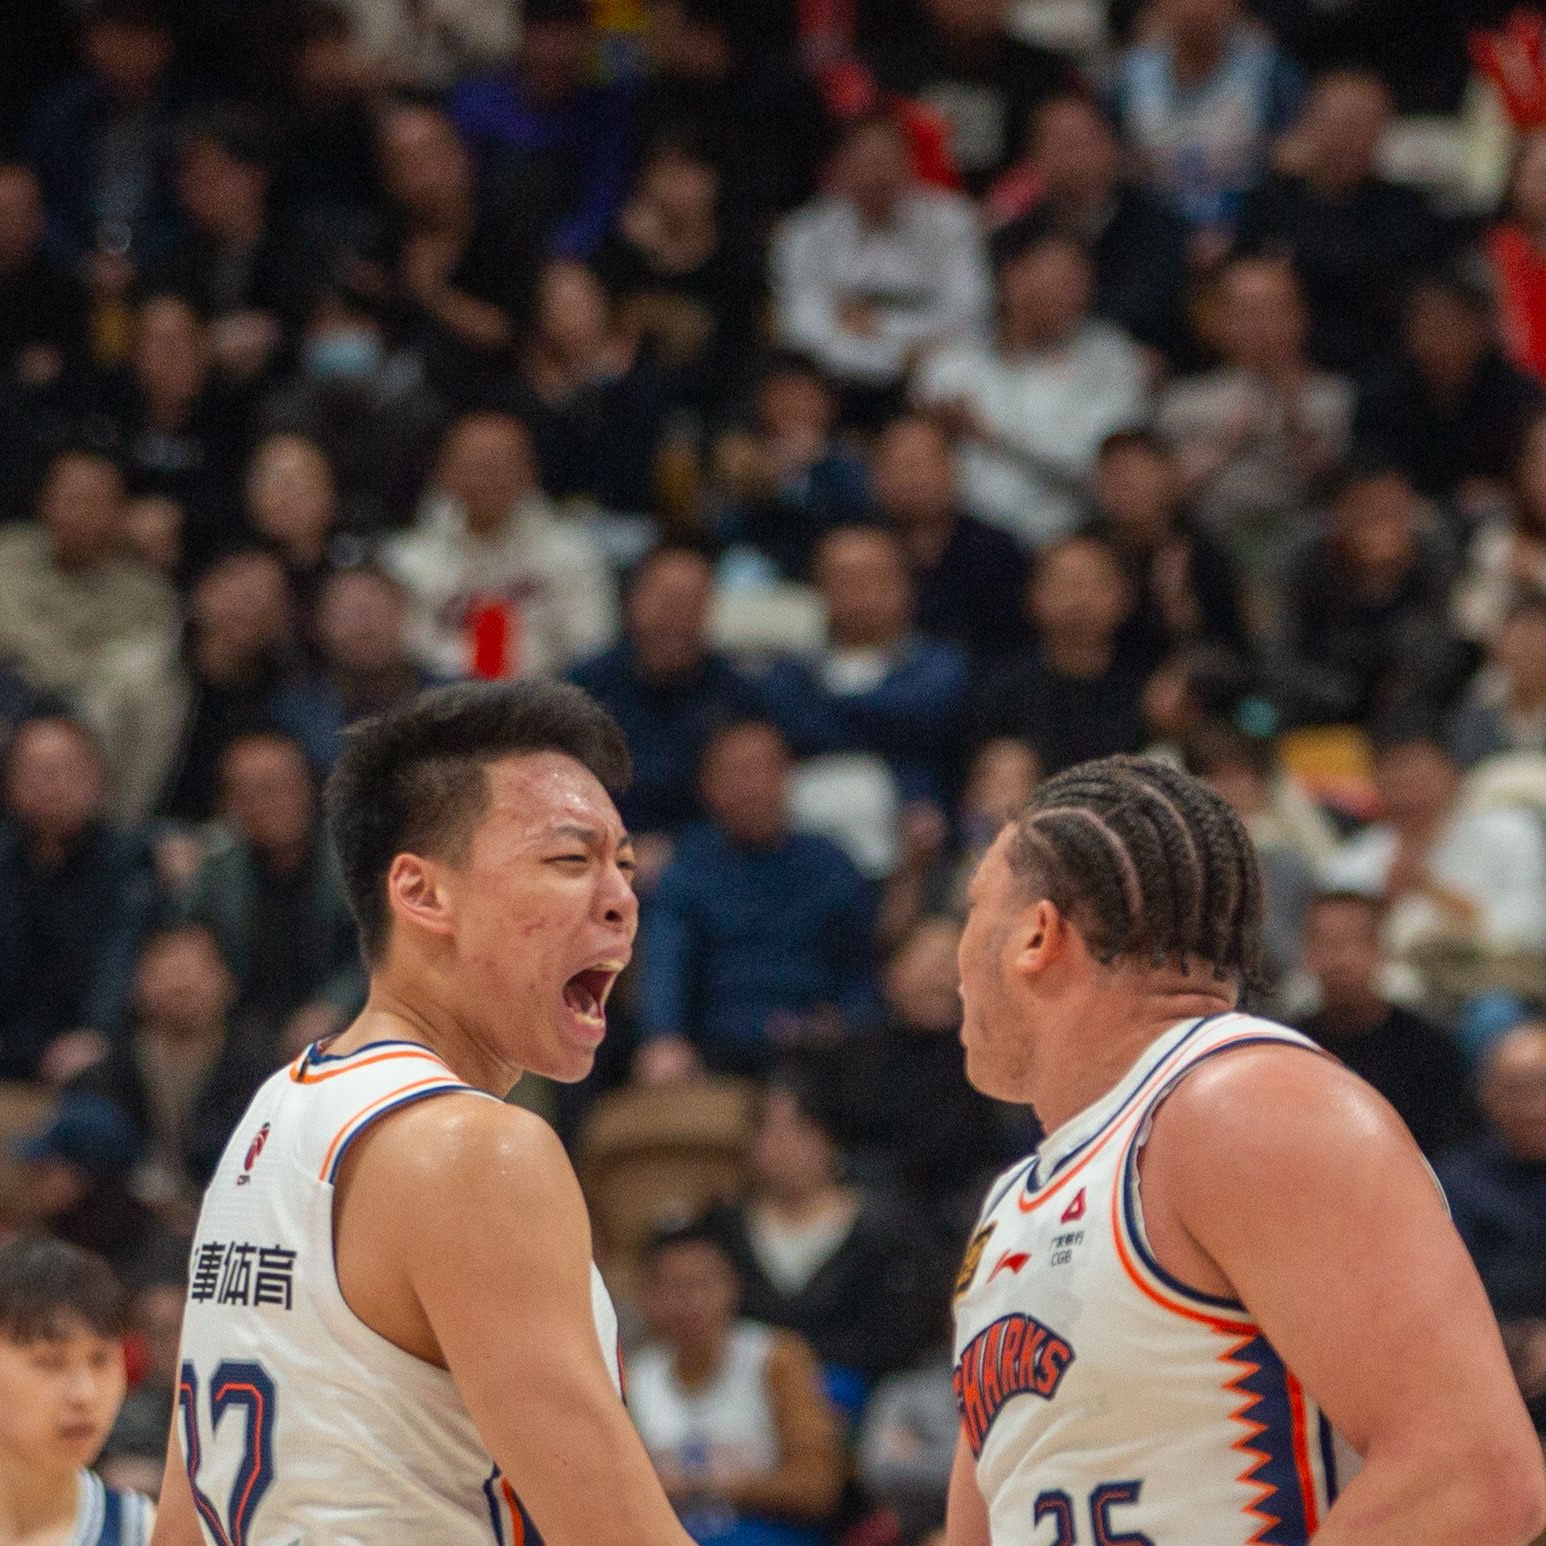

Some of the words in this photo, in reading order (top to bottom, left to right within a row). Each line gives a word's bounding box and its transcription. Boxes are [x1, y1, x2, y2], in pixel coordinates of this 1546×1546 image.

[191, 1240, 297, 1311] 事体育
[952, 1312, 1076, 1462] HARKS
